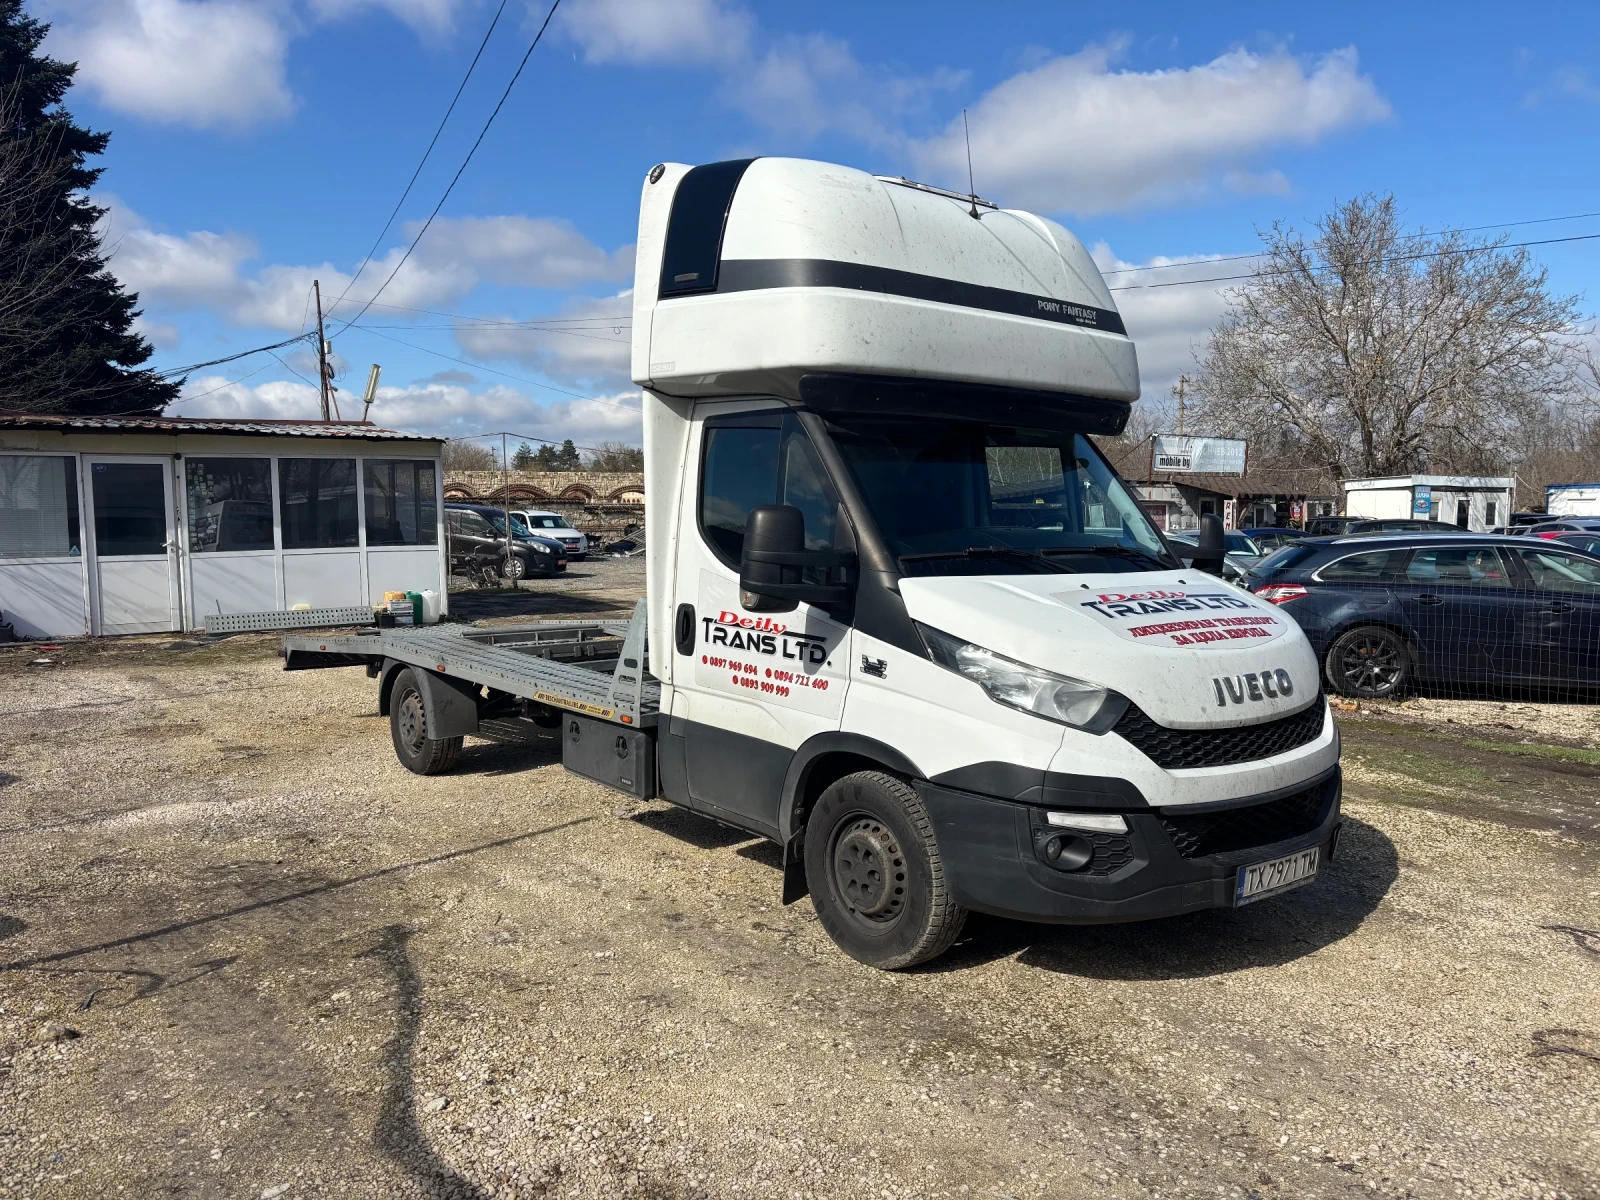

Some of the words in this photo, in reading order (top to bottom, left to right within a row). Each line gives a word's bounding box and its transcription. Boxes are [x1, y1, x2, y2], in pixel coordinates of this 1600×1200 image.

[1037, 300, 1060, 314] PONY
[1062, 304, 1097, 320] FANTASY
[1159, 456, 1181, 467] mobile
[1227, 447, 1243, 457] 2012
[1096, 590, 1187, 603] Deily
[1081, 598, 1201, 619] TRANS
[718, 610, 787, 635] Deily
[702, 617, 777, 655] TRANS
[709, 656, 727, 669] 0897
[728, 660, 742, 672] 969
[743, 664, 758, 676] 694
[740, 676, 759, 690] 0893
[760, 681, 774, 694] 909
[775, 685, 790, 698] 999
[774, 669, 794, 684] 0894
[795, 674, 811, 687] 711
[812, 678, 829, 691] 400
[1212, 668, 1294, 707] IVECO
